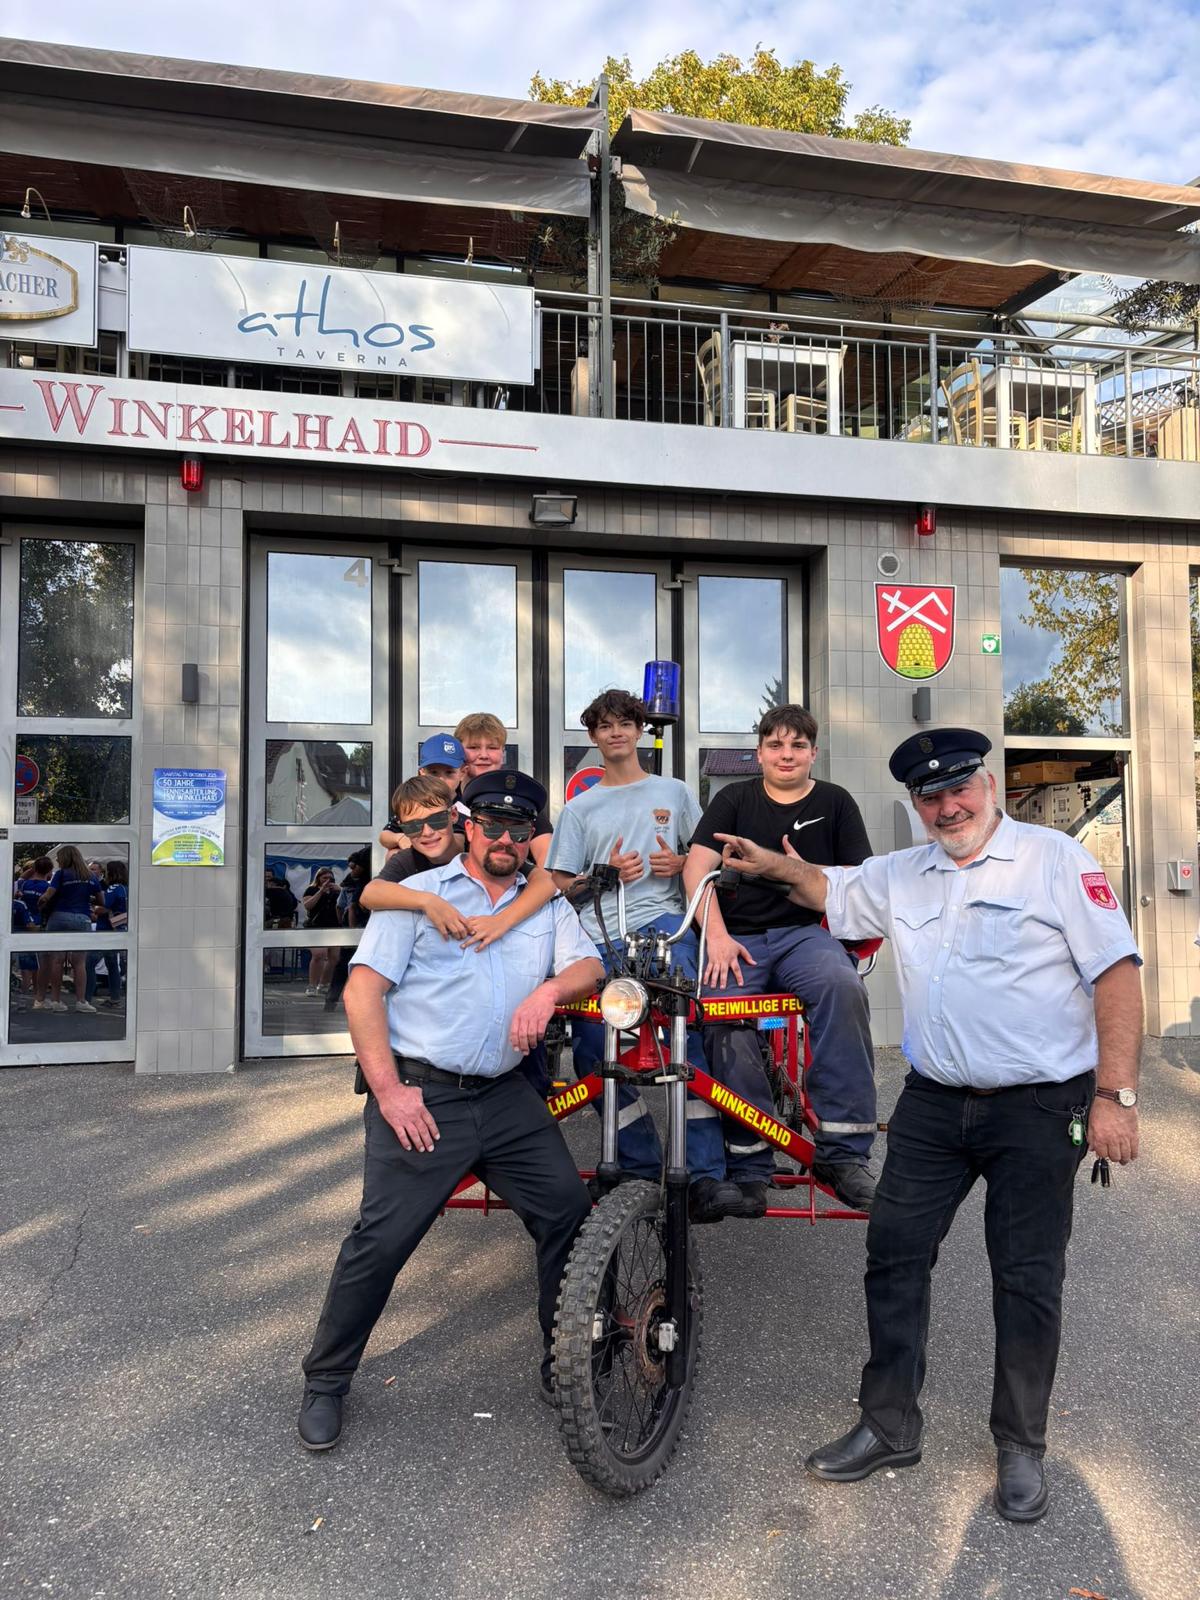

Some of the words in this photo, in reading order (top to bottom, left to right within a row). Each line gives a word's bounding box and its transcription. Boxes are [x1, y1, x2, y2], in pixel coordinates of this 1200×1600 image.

[237, 274, 436, 352] athos
[277, 347, 408, 368] TAVERNA
[344, 559, 369, 587] 4
[163, 779, 173, 787] 50
[174, 779, 194, 787] JAHRE
[177, 794, 218, 802] WINKELHAID
[703, 999, 779, 1016] FREIWILLIGE
[710, 1082, 792, 1147] WINKELHAID
